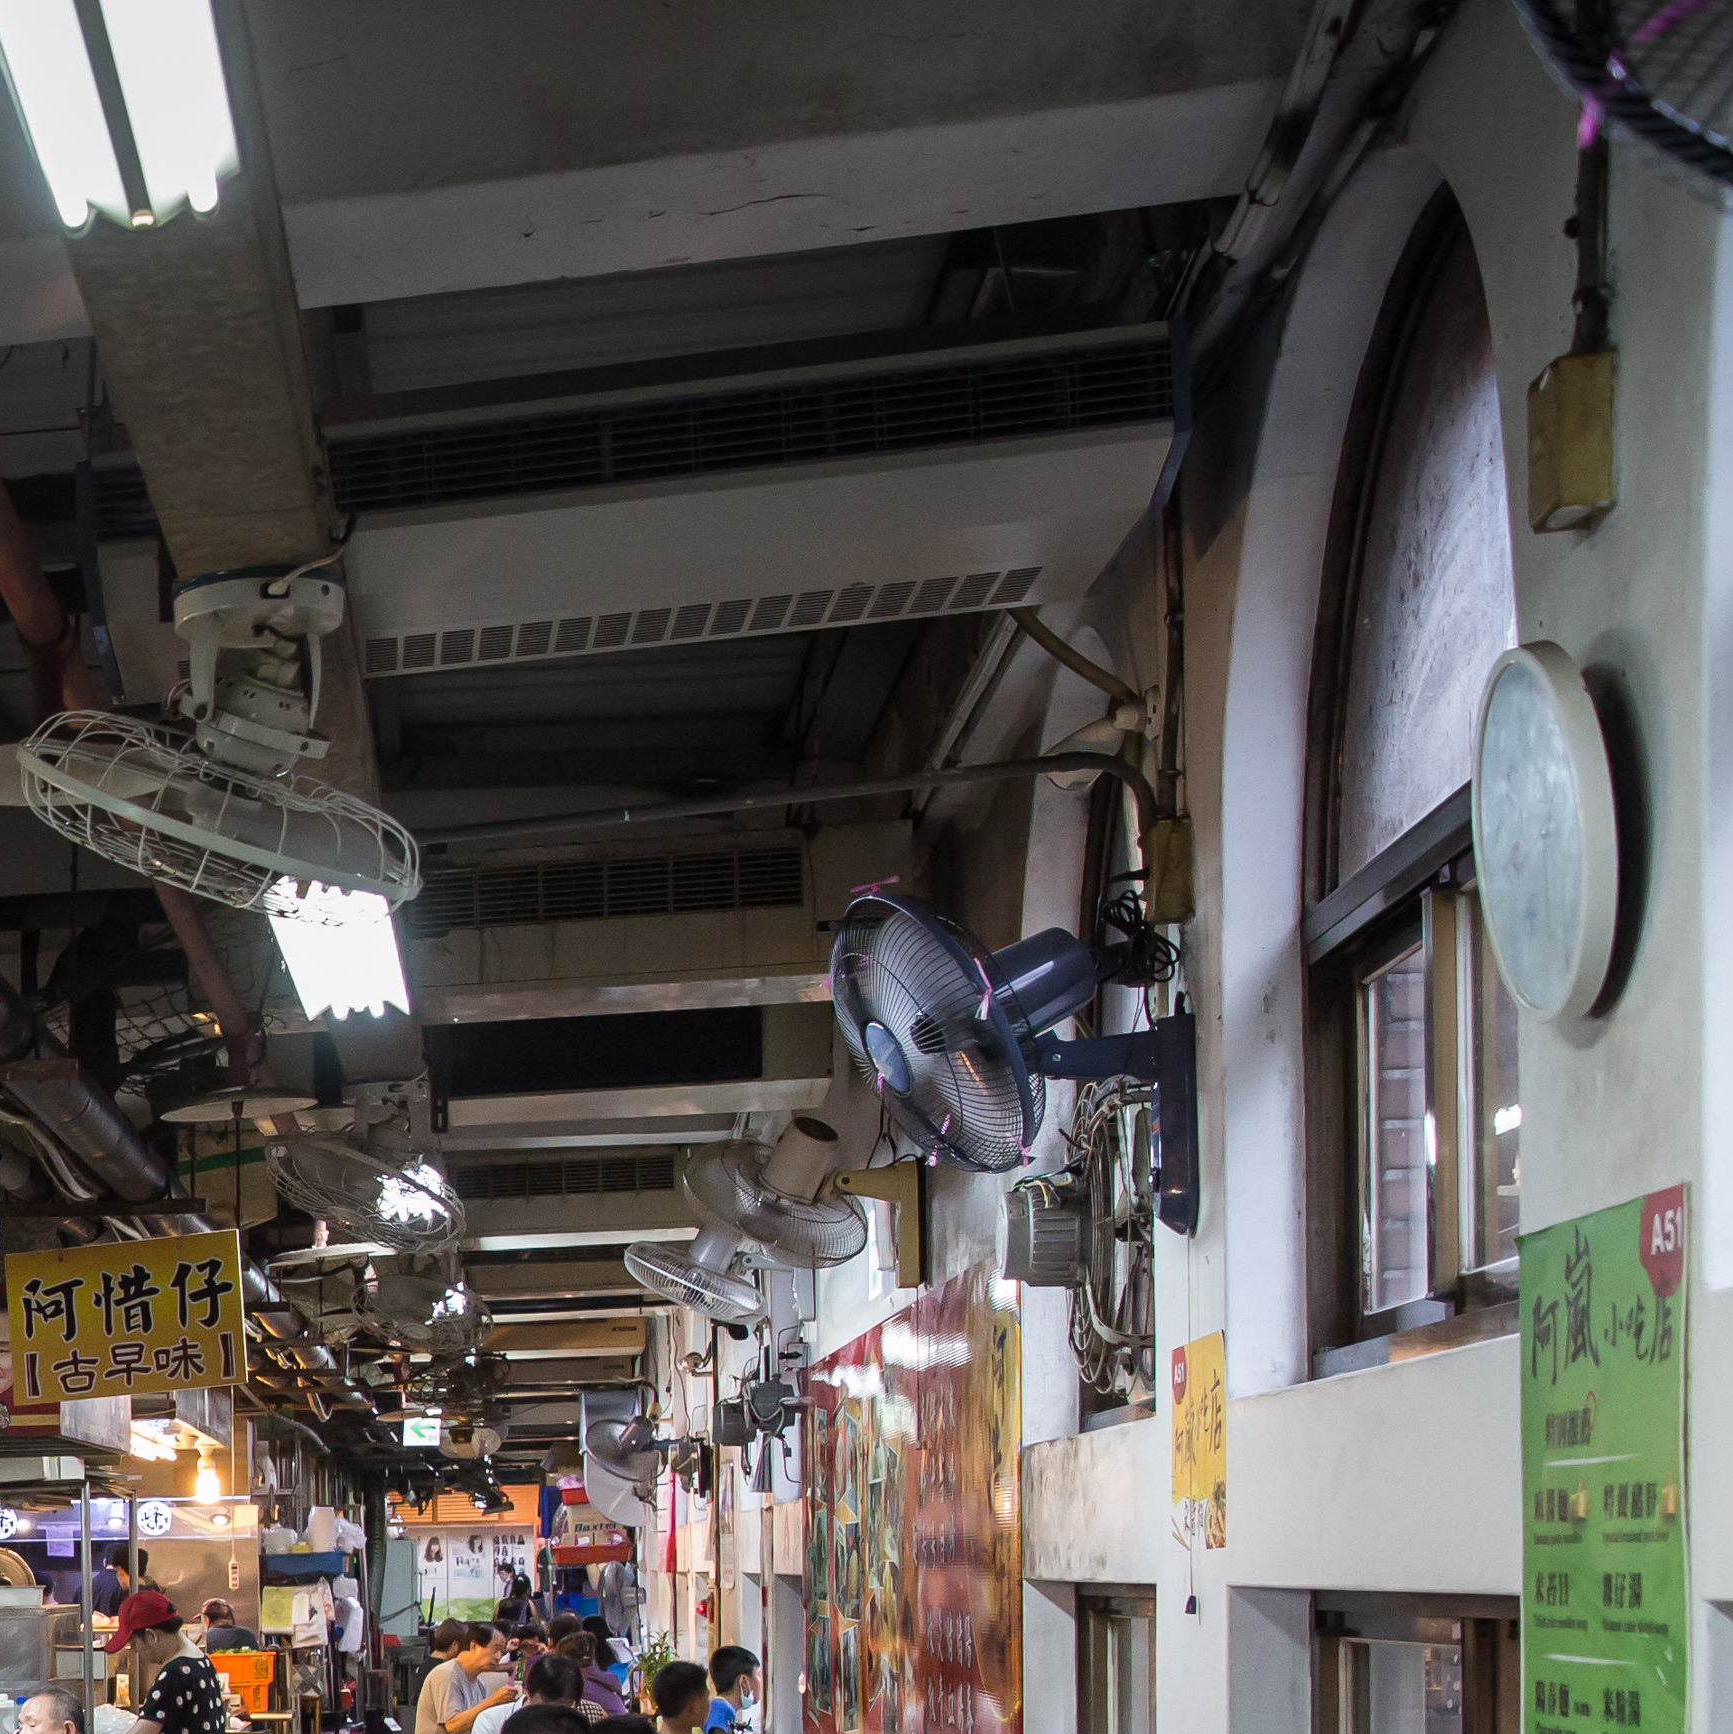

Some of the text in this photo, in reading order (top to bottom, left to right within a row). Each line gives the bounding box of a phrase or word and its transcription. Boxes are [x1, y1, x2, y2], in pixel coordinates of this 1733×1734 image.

[1650, 1205, 1684, 1256] A51
[21, 1258, 234, 1342] 阿惜仔
[1531, 1223, 1674, 1386] 阿嵐 小吃店
[1173, 1362, 1185, 1385] A51
